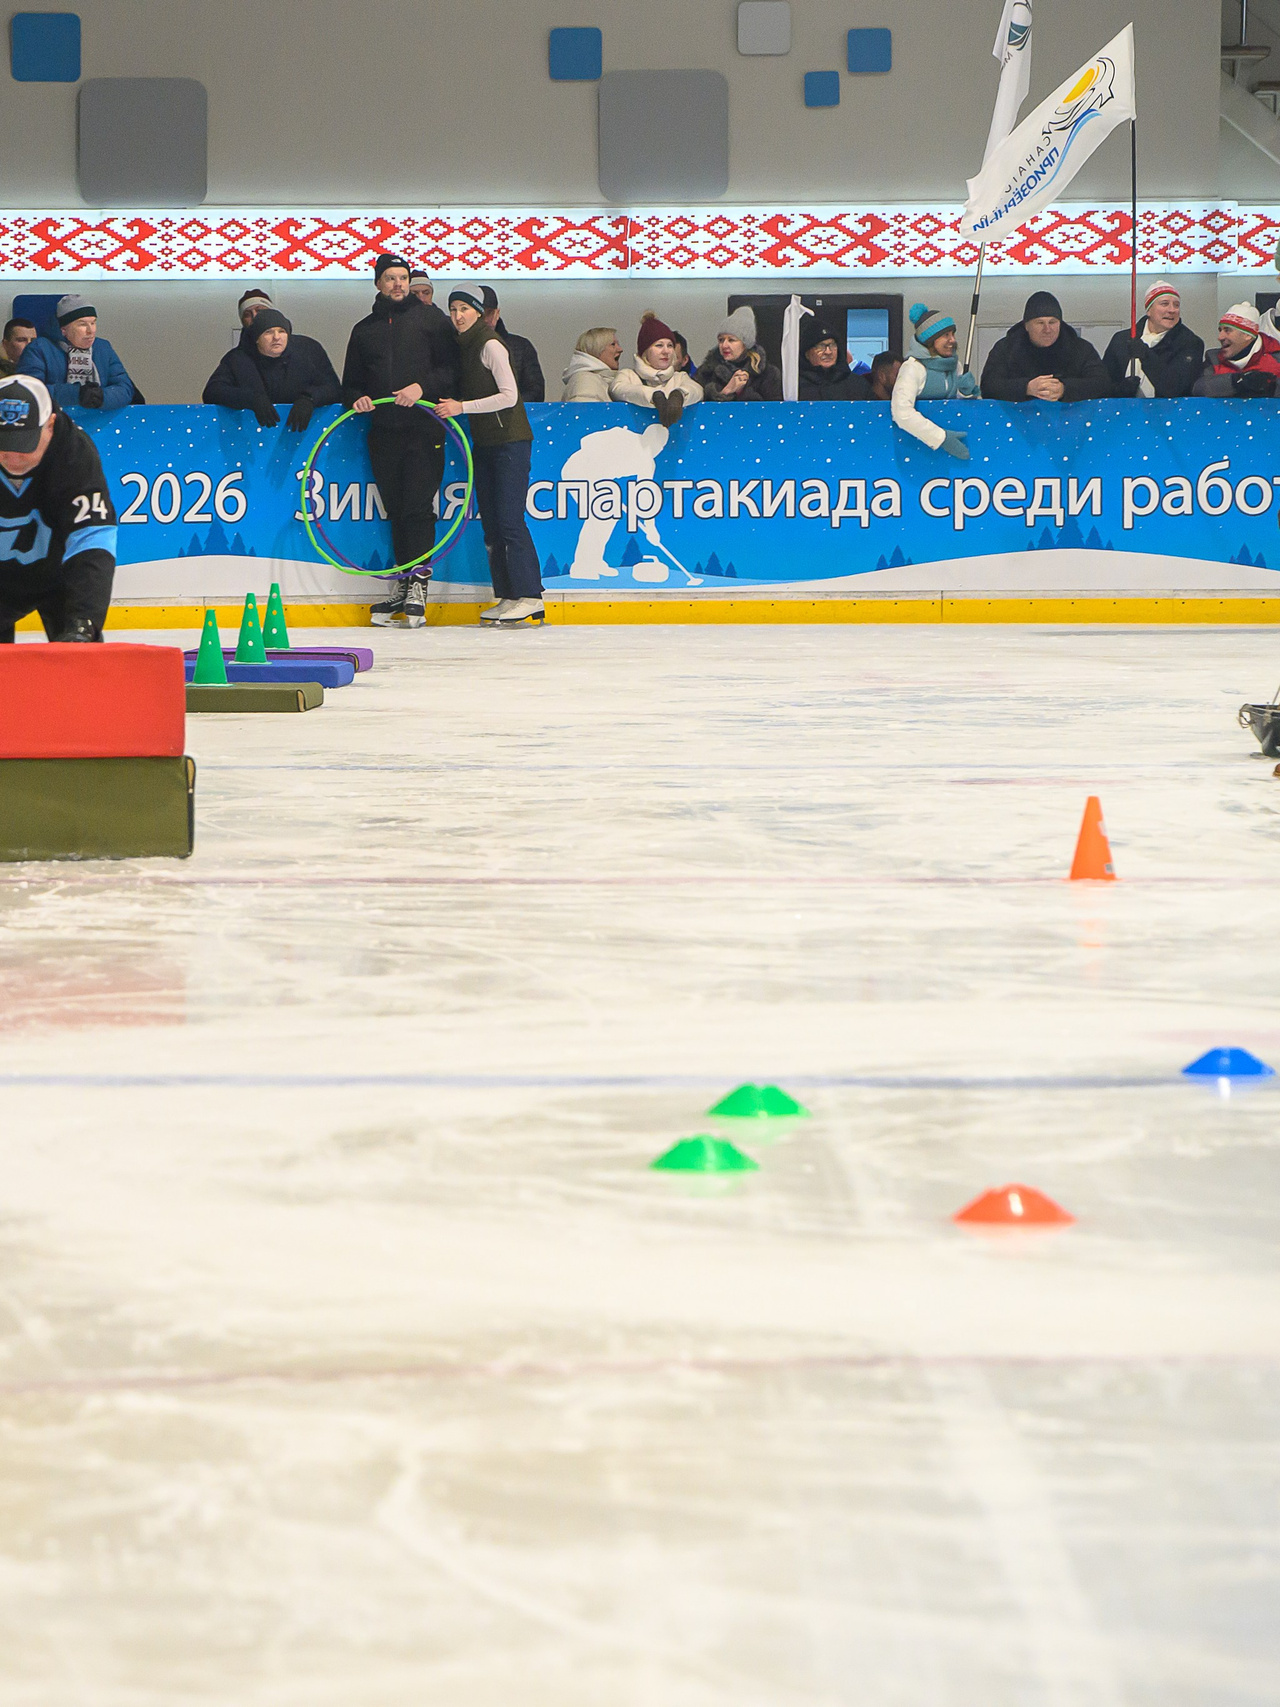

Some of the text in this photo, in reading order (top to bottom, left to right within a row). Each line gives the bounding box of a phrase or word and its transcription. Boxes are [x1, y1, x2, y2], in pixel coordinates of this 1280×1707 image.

[72, 492, 109, 524] 24
[120, 471, 247, 524] 2026
[525, 475, 902, 532] спартакиада
[919, 475, 1103, 531] среди
[1121, 459, 1280, 531] рабо
